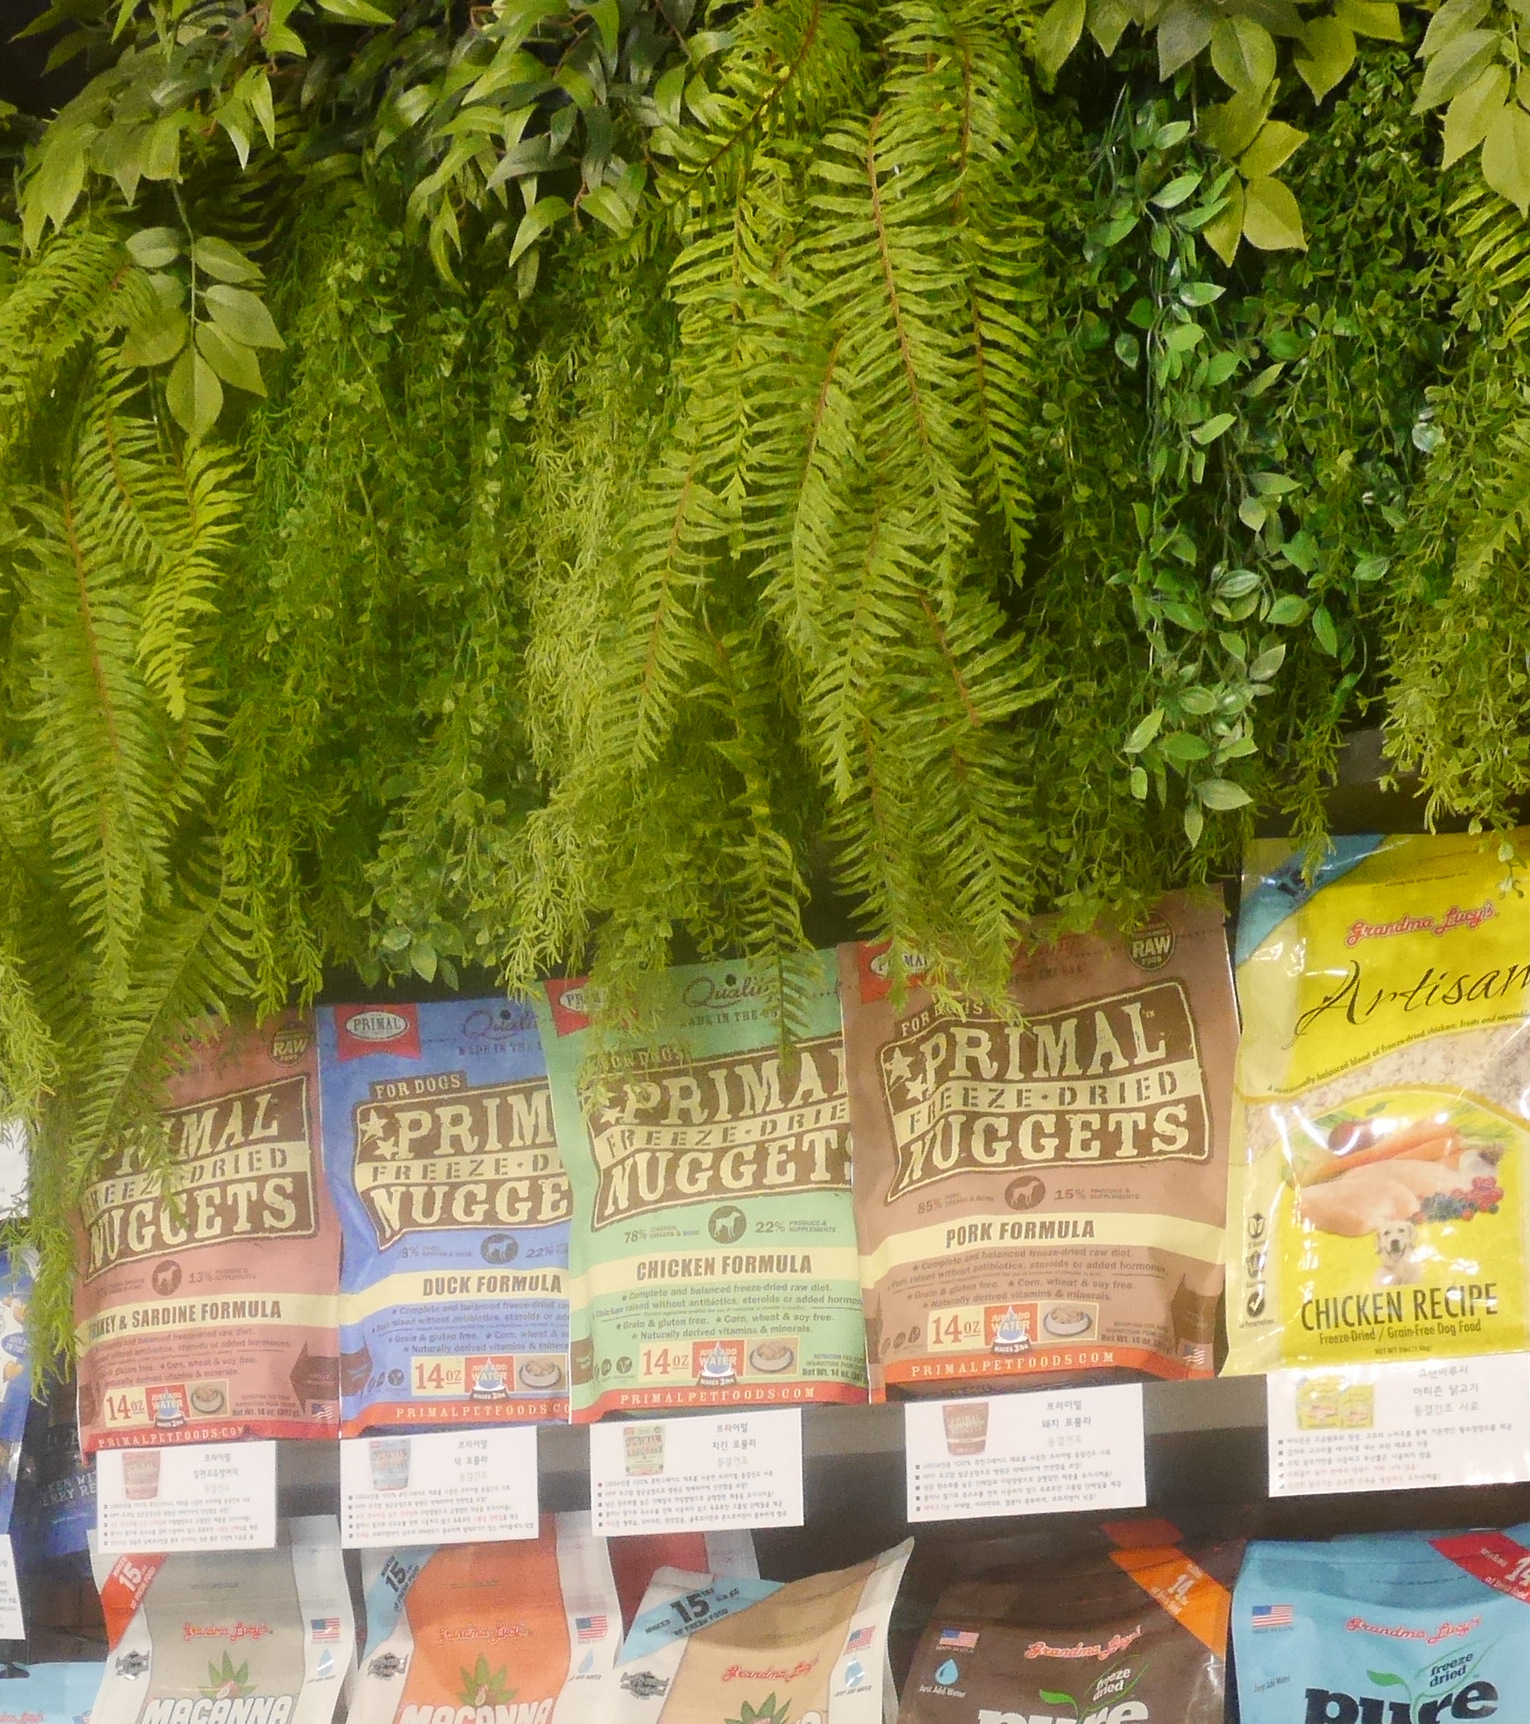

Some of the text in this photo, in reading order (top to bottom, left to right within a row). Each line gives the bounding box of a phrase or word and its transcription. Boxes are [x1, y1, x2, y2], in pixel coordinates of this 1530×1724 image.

[923, 1002, 1167, 1086] PRIMAL
[376, 1076, 461, 1099] FOR DOGS
[900, 1104, 1189, 1189] NUGGETS
[946, 1219, 1095, 1248] PORK FORMULA
[637, 1255, 812, 1281] CHICKEN FORMULA
[423, 1275, 562, 1297] DUCK FORMULA
[132, 1303, 281, 1327] SARDINE FORMULA
[1301, 1283, 1498, 1331] CHICKEN RECIPE
[932, 1315, 963, 1345] 14
[1093, 1680, 1124, 1701] dried
